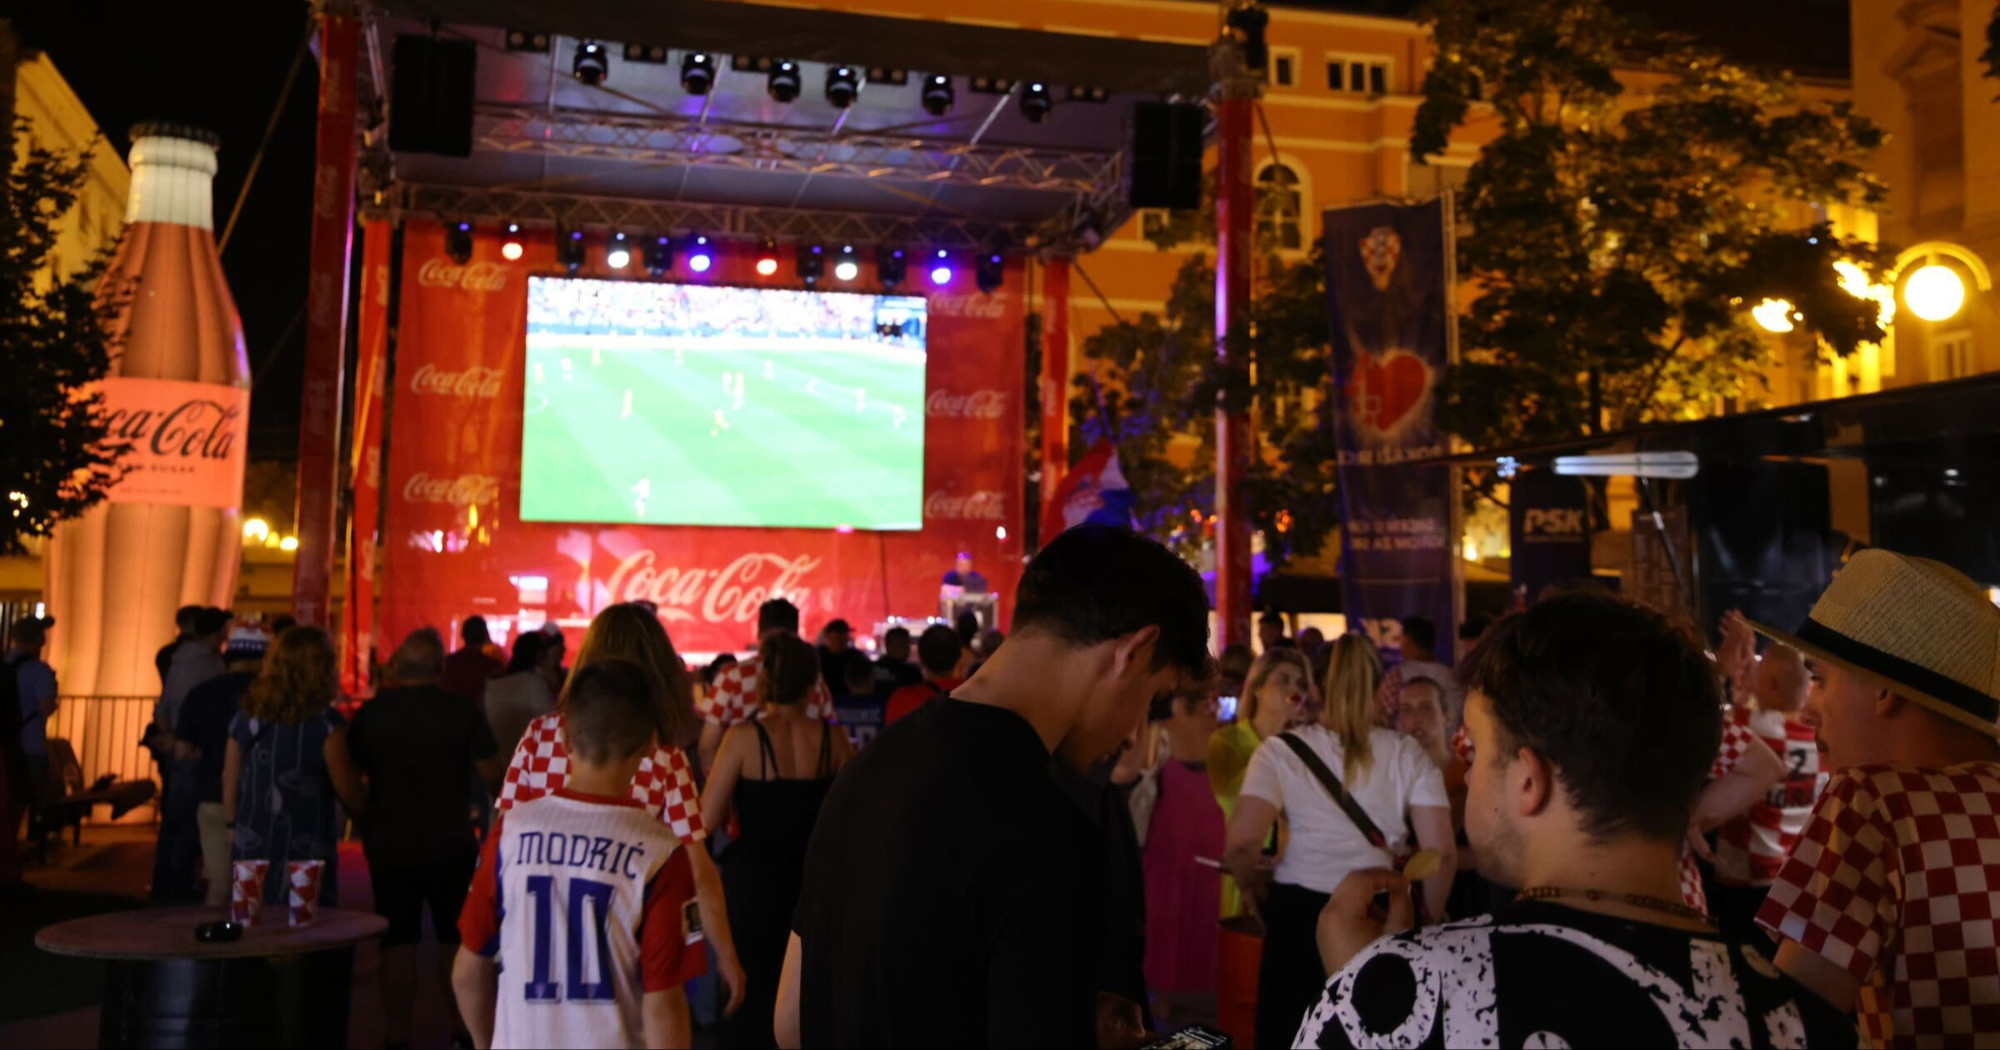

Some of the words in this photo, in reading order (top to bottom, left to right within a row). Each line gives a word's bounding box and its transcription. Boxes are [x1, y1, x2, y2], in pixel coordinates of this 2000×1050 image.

[1523, 508, 1584, 534] PSK
[516, 831, 645, 880] MODRIĆ
[524, 875, 617, 1003] 10
